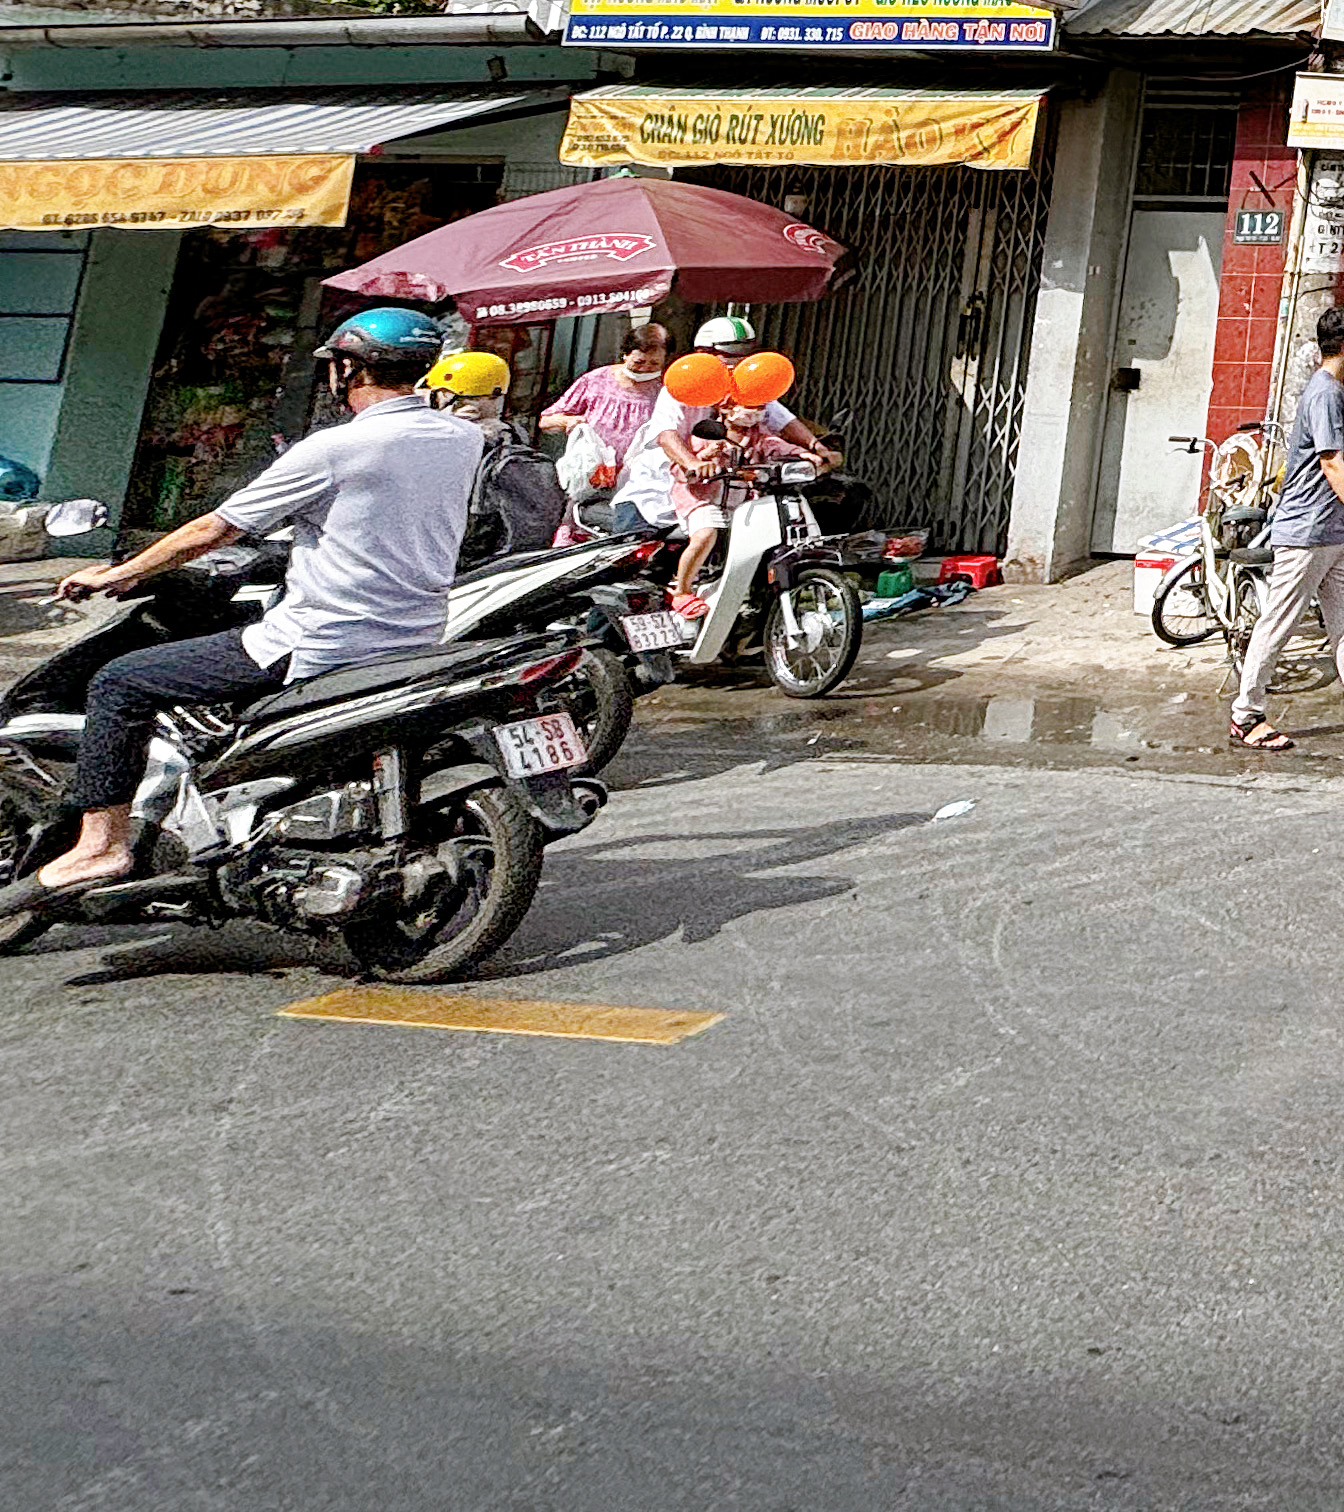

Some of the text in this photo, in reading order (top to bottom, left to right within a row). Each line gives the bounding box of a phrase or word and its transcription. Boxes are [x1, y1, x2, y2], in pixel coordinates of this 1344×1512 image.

[849, 20, 898, 41] GIAO
[902, 18, 958, 42] HÀNG
[963, 19, 1006, 46] TẬN
[1008, 21, 1047, 42] NƠI
[639, 105, 688, 145] CHÂN
[692, 105, 722, 145] GIÒ
[727, 105, 763, 145] RÚT
[1239, 212, 1281, 236] 112
